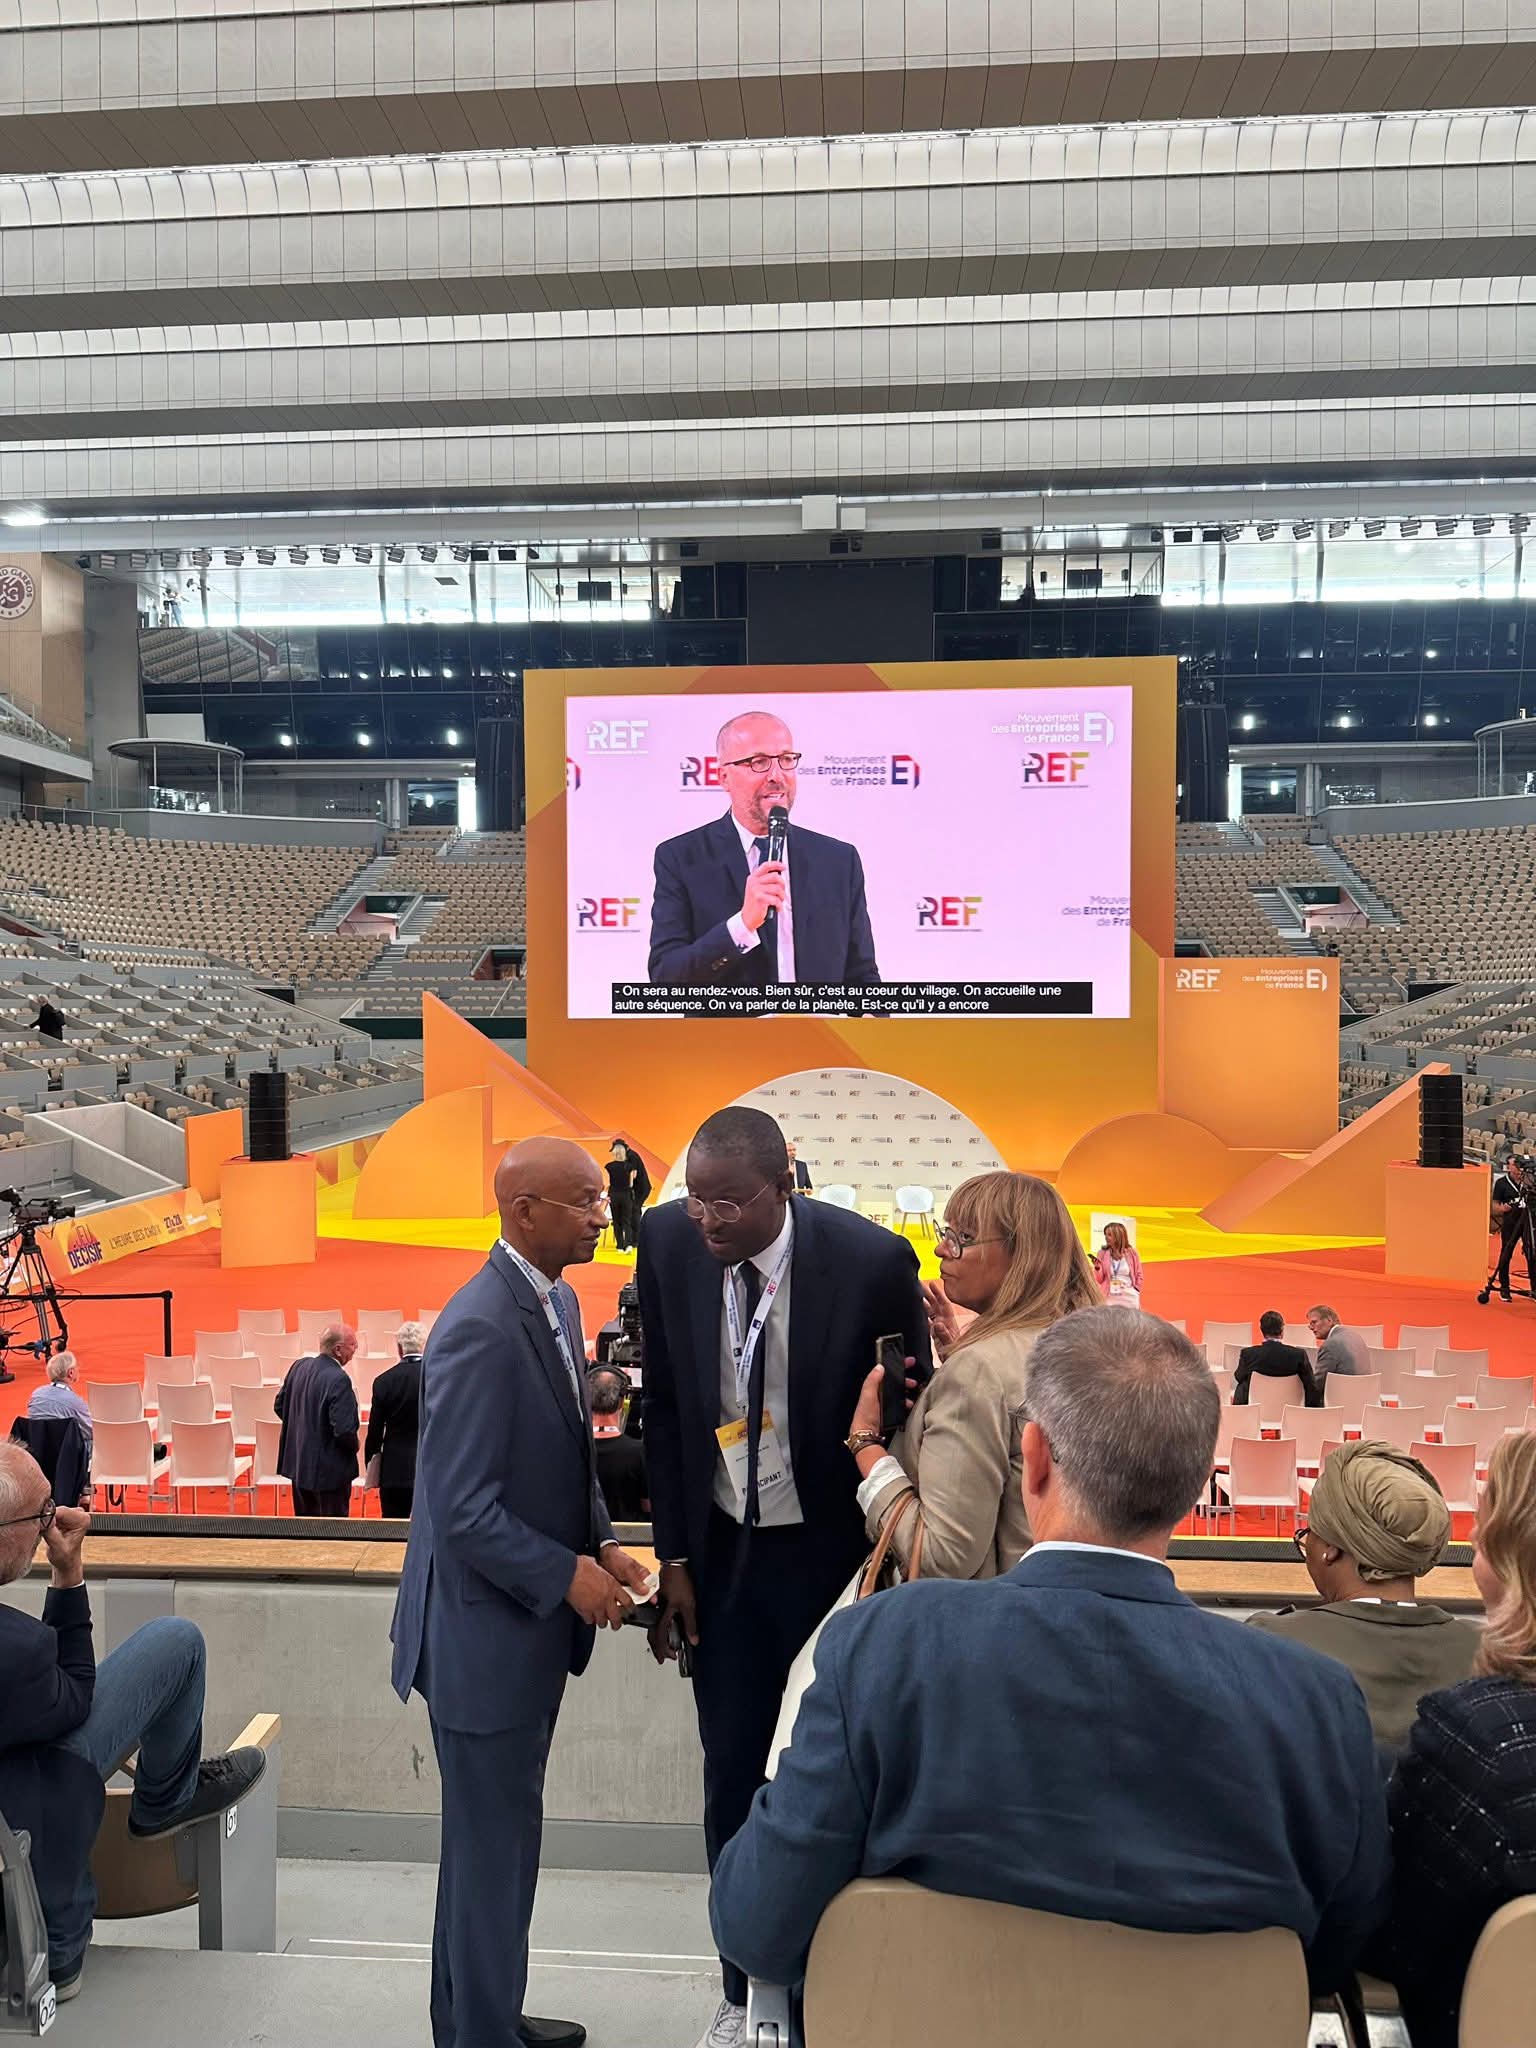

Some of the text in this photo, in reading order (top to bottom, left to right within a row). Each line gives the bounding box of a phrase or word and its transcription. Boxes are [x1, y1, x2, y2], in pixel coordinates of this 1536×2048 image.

[1017, 712, 1080, 722] Mouvement
[588, 720, 649, 749] REF
[1011, 723, 1080, 734] Entreprises
[1024, 734, 1080, 744] de France
[824, 755, 887, 765] Mouvement
[798, 765, 887, 776] des Entreprises
[1024, 752, 1090, 783] REF
[831, 777, 887, 786] de France
[579, 898, 641, 927] REF
[919, 896, 983, 926] REF
[1062, 907, 1082, 916] des
[1096, 917, 1111, 926] de
[1177, 969, 1221, 988] REF
[623, 985, 640, 996] On
[643, 987, 668, 996] sera
[671, 987, 686, 996] au
[688, 985, 762, 996] rendez-vous.
[765, 985, 792, 996] Bien
[794, 984, 815, 998] sûr,
[818, 985, 846, 996] c'est
[848, 987, 863, 996] au
[865, 987, 899, 996] coeur
[902, 985, 916, 996] du
[919, 985, 960, 998] village.
[963, 985, 981, 996] On
[984, 985, 1036, 996] accueille
[1039, 987, 1062, 996] une
[615, 999, 990, 1013] autre séquence. On va parler de la planète. Est-ce qu'il y a encore
[40, 1998, 56, 2028] 02
